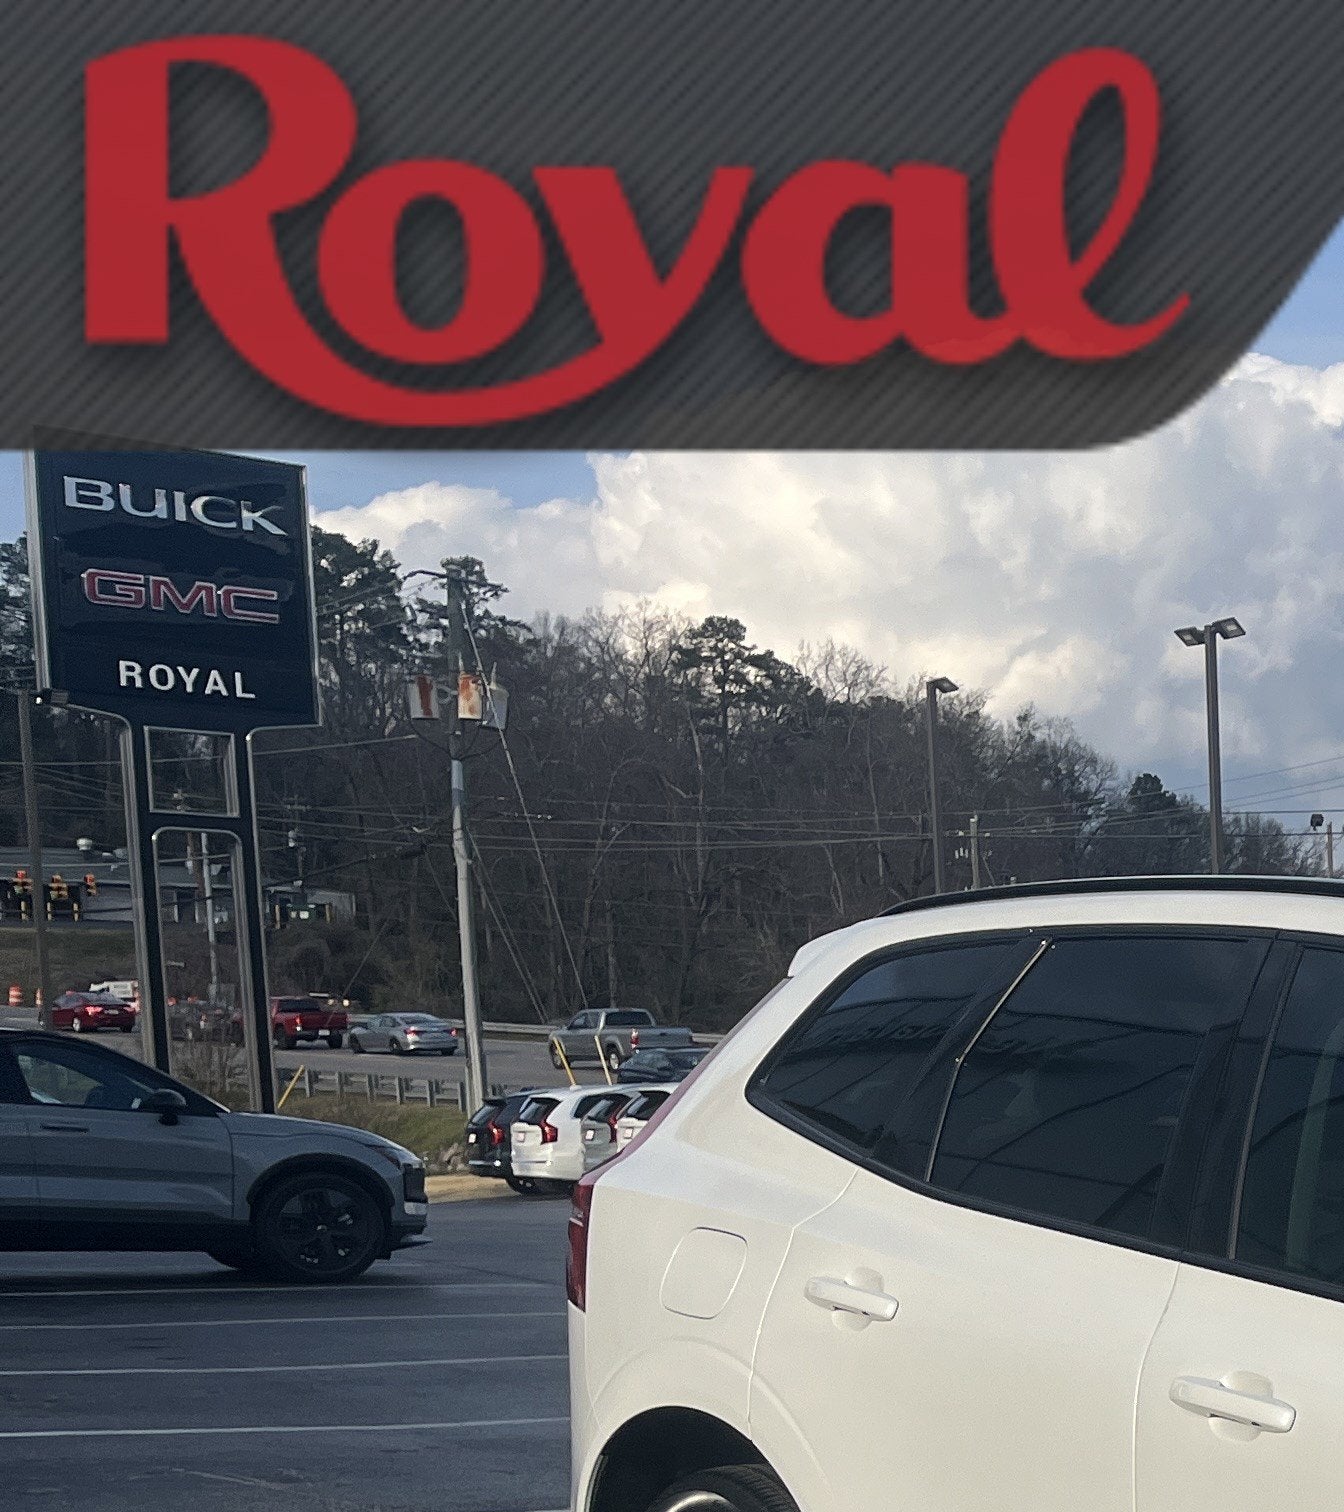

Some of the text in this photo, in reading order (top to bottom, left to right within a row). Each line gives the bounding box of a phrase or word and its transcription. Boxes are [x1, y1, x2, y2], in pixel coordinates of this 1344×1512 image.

[63, 475, 288, 535] BUICK
[82, 568, 281, 624] GMC
[119, 660, 256, 699] ROYAL
